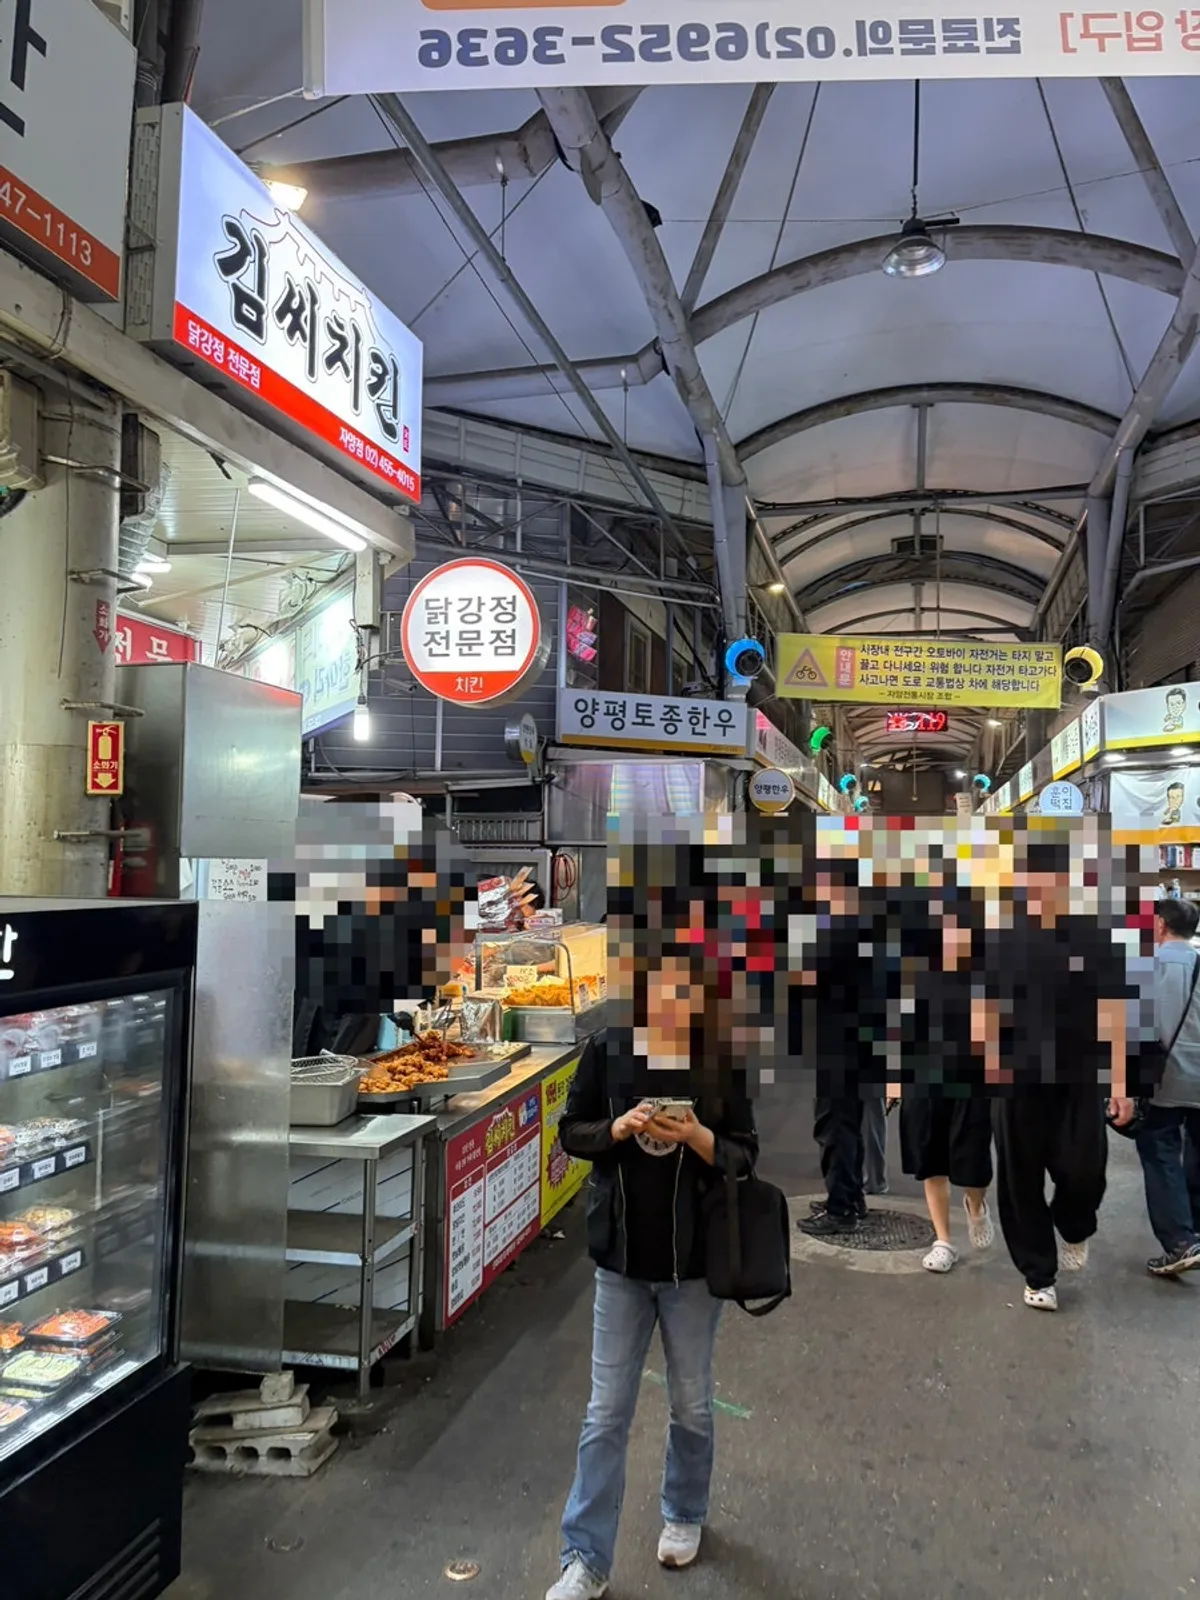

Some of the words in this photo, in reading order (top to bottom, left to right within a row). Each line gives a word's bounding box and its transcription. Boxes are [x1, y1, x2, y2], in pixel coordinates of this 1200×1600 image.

[215, 216, 400, 443] 김씨치킨
[187, 318, 225, 365] 닭강정
[227, 348, 262, 390] 전문점
[340, 426, 364, 459] 자양점
[365, 445, 379, 468] 02)
[379, 455, 415, 492] 455-4015
[424, 595, 517, 625] 닭강정
[423, 628, 516, 658] 전문점
[861, 644, 890, 656] 시장내
[894, 645, 923, 658] 전구간
[926, 646, 965, 659] 오토바이
[969, 648, 1008, 660] 자전거는
[1012, 650, 1031, 662] 타지
[1035, 650, 1053, 662] 말고
[883, 660, 926, 673] 다니세요!
[930, 661, 949, 674] 위험
[953, 663, 982, 675] 합니다
[986, 664, 1014, 676] 자전거
[1018, 665, 1057, 677] 타고가다
[455, 676, 483, 694] 치킨
[859, 674, 898, 686] 사고나면
[902, 675, 922, 687] 도로
[926, 676, 964, 689] 교통법상
[992, 679, 1040, 692] 해당합니다
[573, 697, 736, 738] 양평토종한우
[92, 761, 118, 771] 소화기
[753, 783, 789, 795] 양평한우
